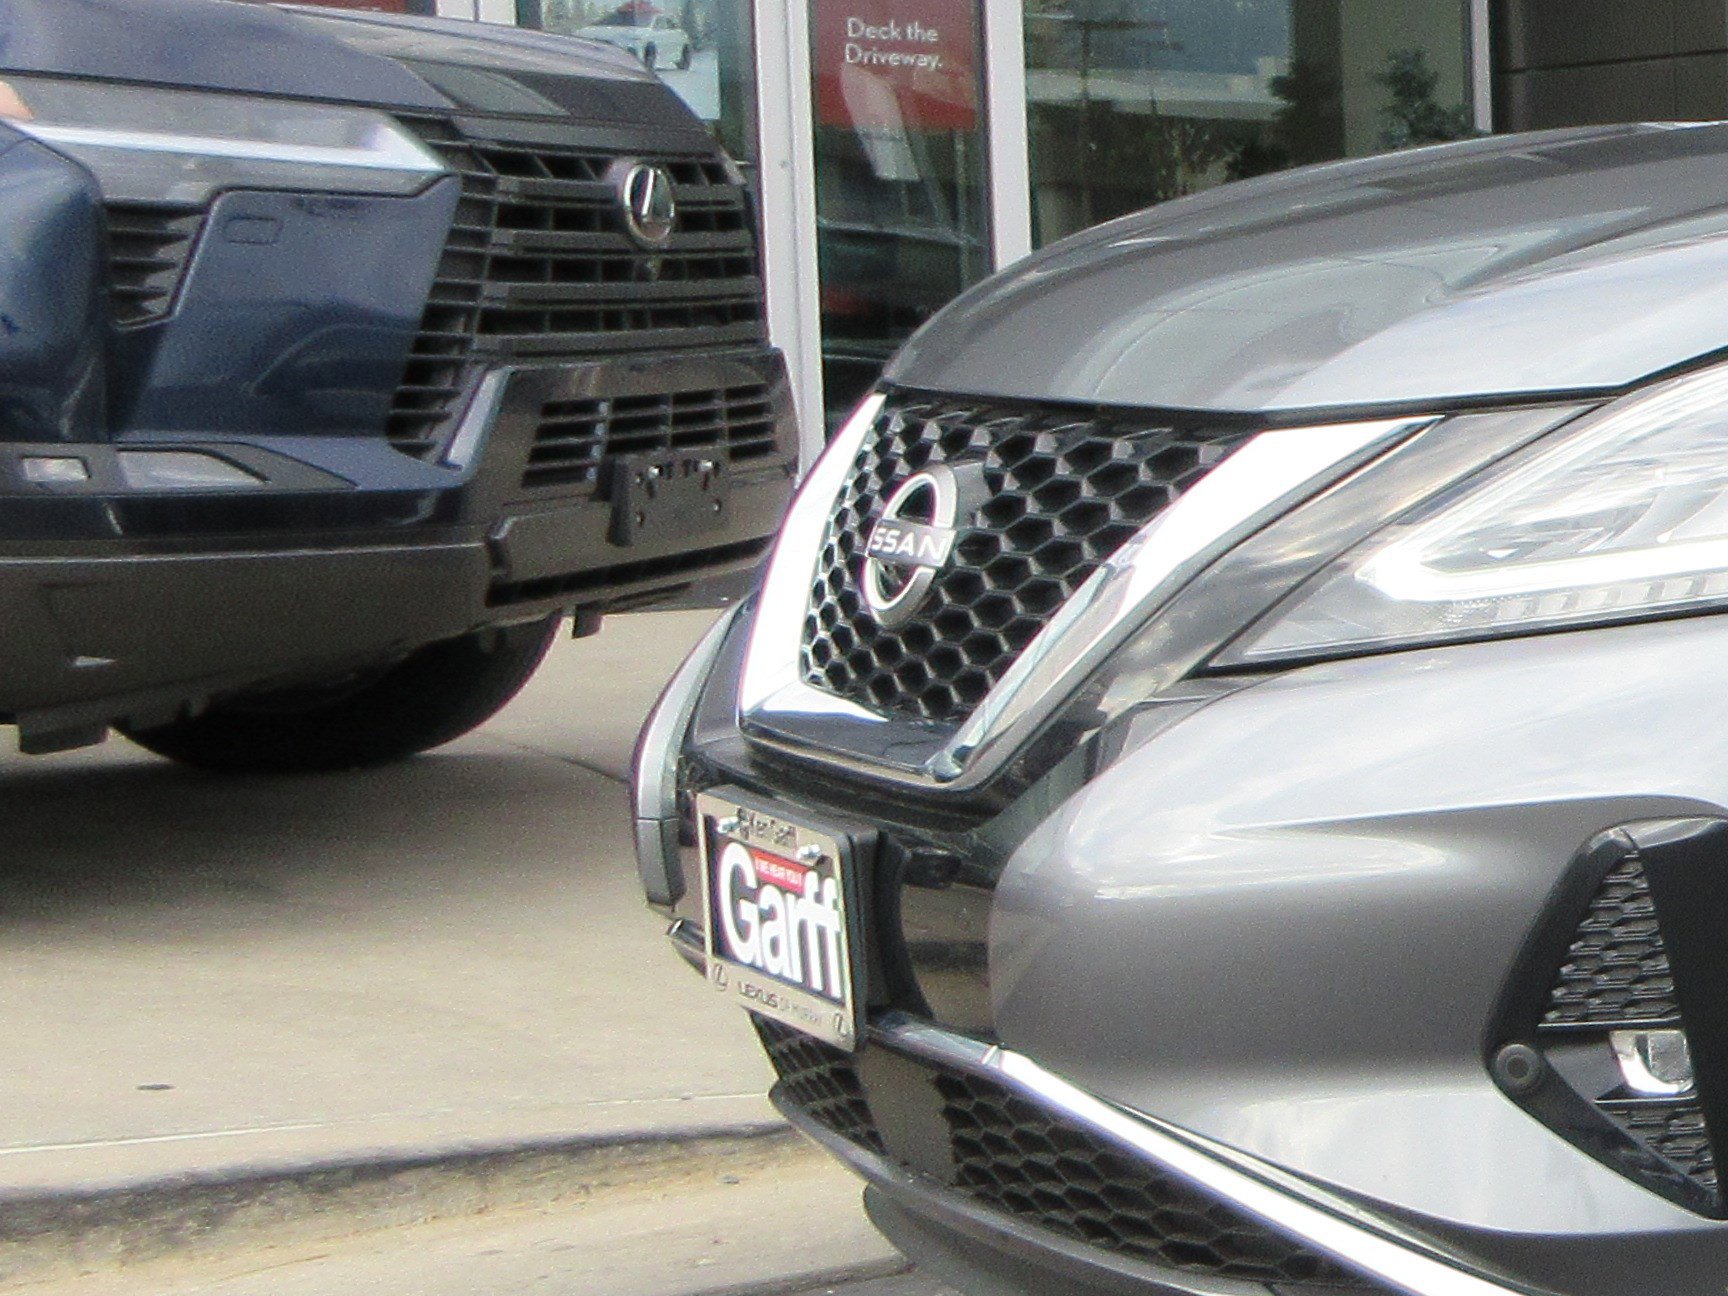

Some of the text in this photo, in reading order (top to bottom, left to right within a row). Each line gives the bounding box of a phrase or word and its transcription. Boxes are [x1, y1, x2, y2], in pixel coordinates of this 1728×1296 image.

[846, 16, 940, 43] Deck the
[844, 42, 943, 71] Driveway.
[871, 527, 948, 560] SSAN
[718, 841, 842, 1000] Garff
